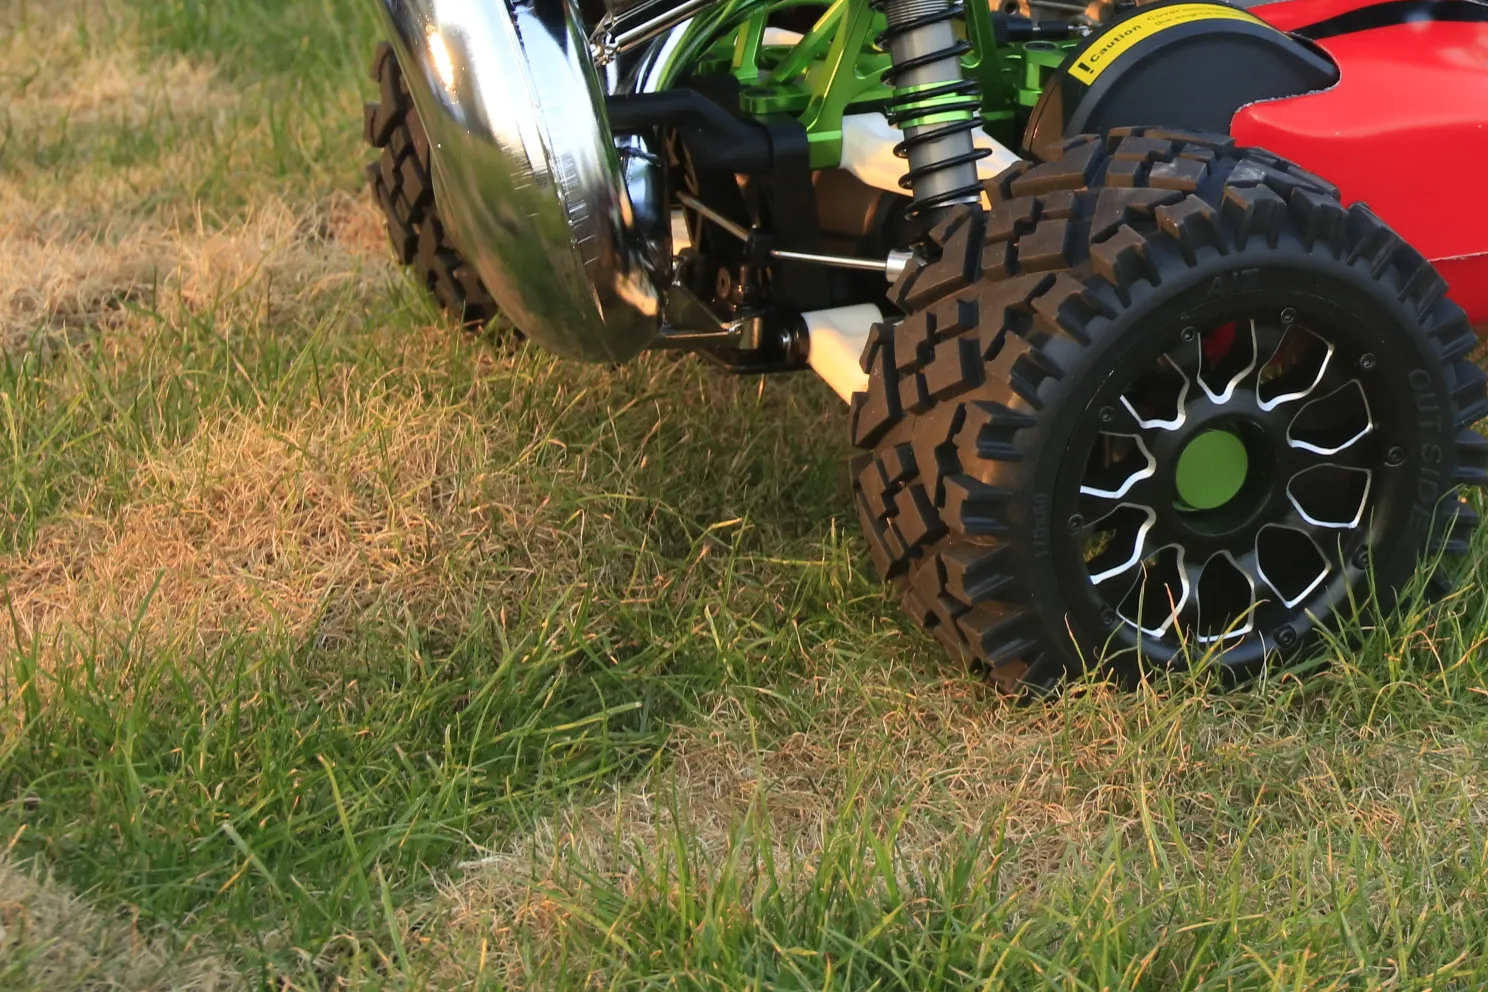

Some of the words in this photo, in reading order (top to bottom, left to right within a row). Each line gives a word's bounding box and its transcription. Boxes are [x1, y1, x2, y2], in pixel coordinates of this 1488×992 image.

[1090, 25, 1142, 62] Caution
[1408, 368, 1443, 434] OUT
[1408, 442, 1443, 533] SIDE
